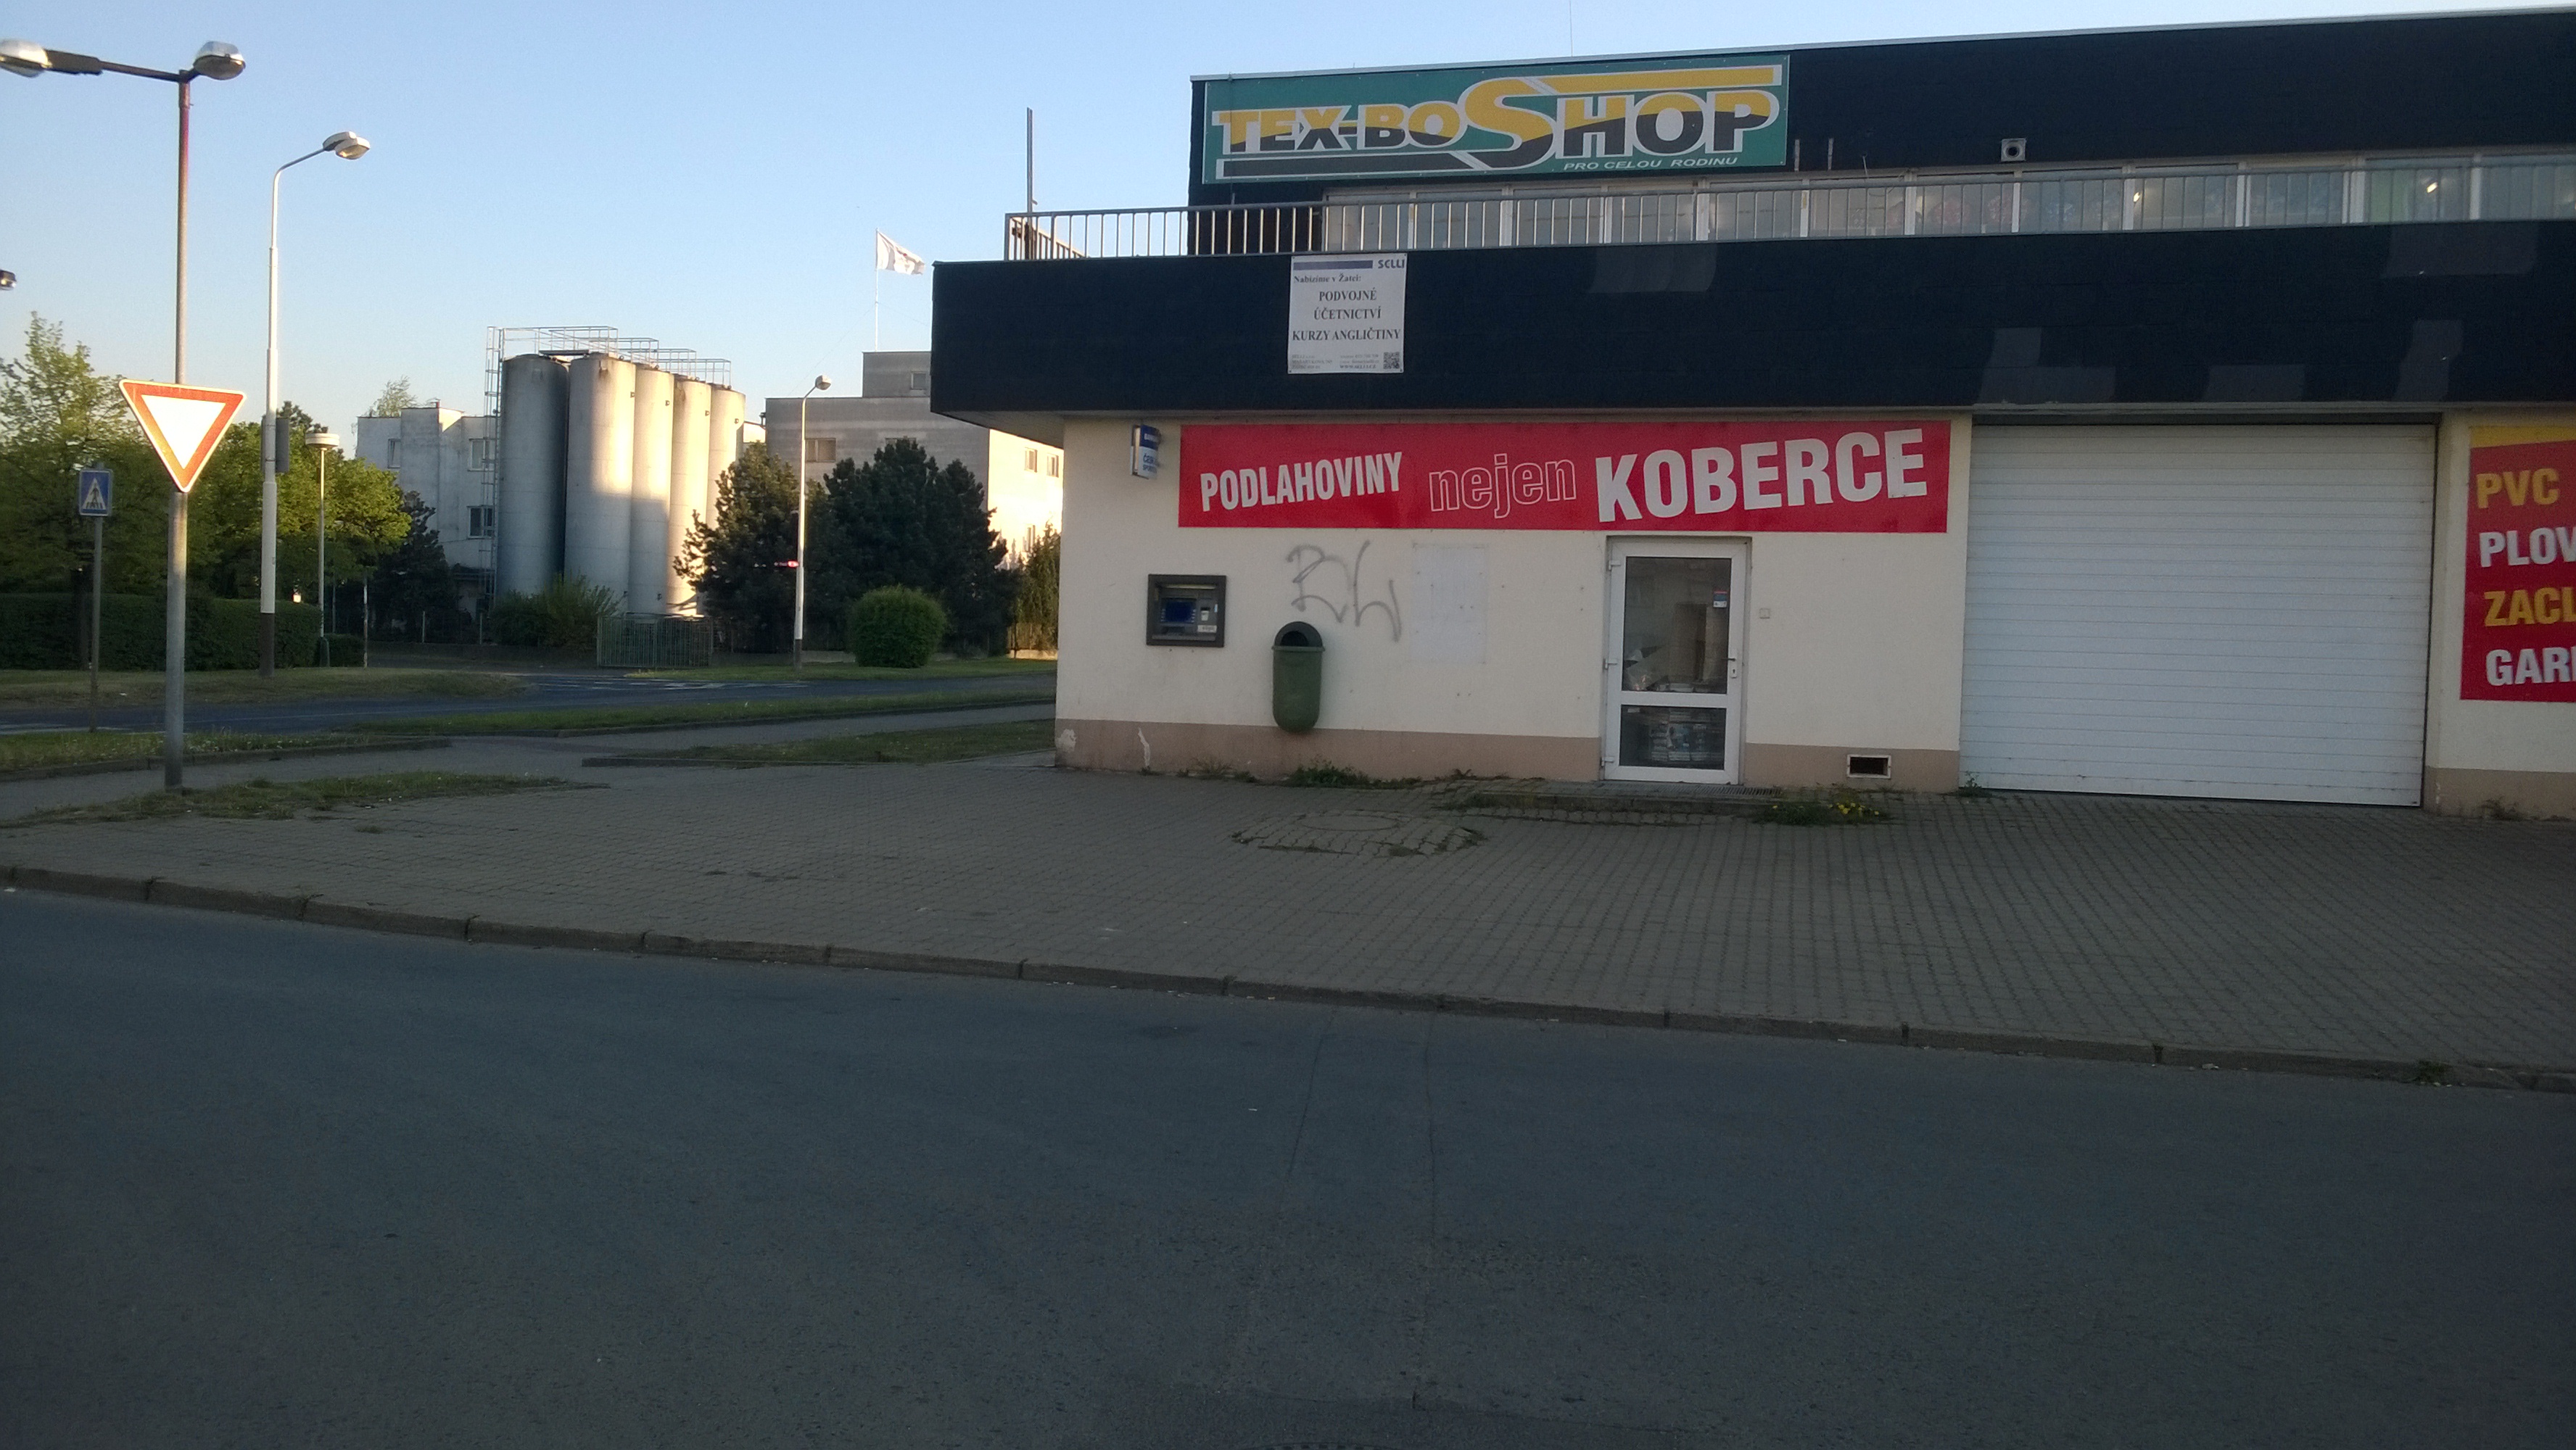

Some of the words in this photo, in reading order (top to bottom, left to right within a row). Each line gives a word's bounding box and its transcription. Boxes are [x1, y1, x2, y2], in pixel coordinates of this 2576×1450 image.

[1563, 162, 1599, 171] PRO
[1603, 160, 1662, 170] CELOU
[1670, 157, 1738, 167] RODINU
[1318, 287, 1377, 302] PODVOJNÉ
[1313, 306, 1382, 320] ÚČETNICTVÍ
[1292, 330, 1331, 341] KURZY
[1332, 327, 1401, 341] ANGLIČTINY
[1200, 452, 1403, 512] PODLAHOVINY
[1429, 452, 1577, 519] nejen
[1595, 428, 1928, 523] KOBERCE
[2476, 468, 2560, 509] PVC
[2486, 646, 2576, 686] GAR
